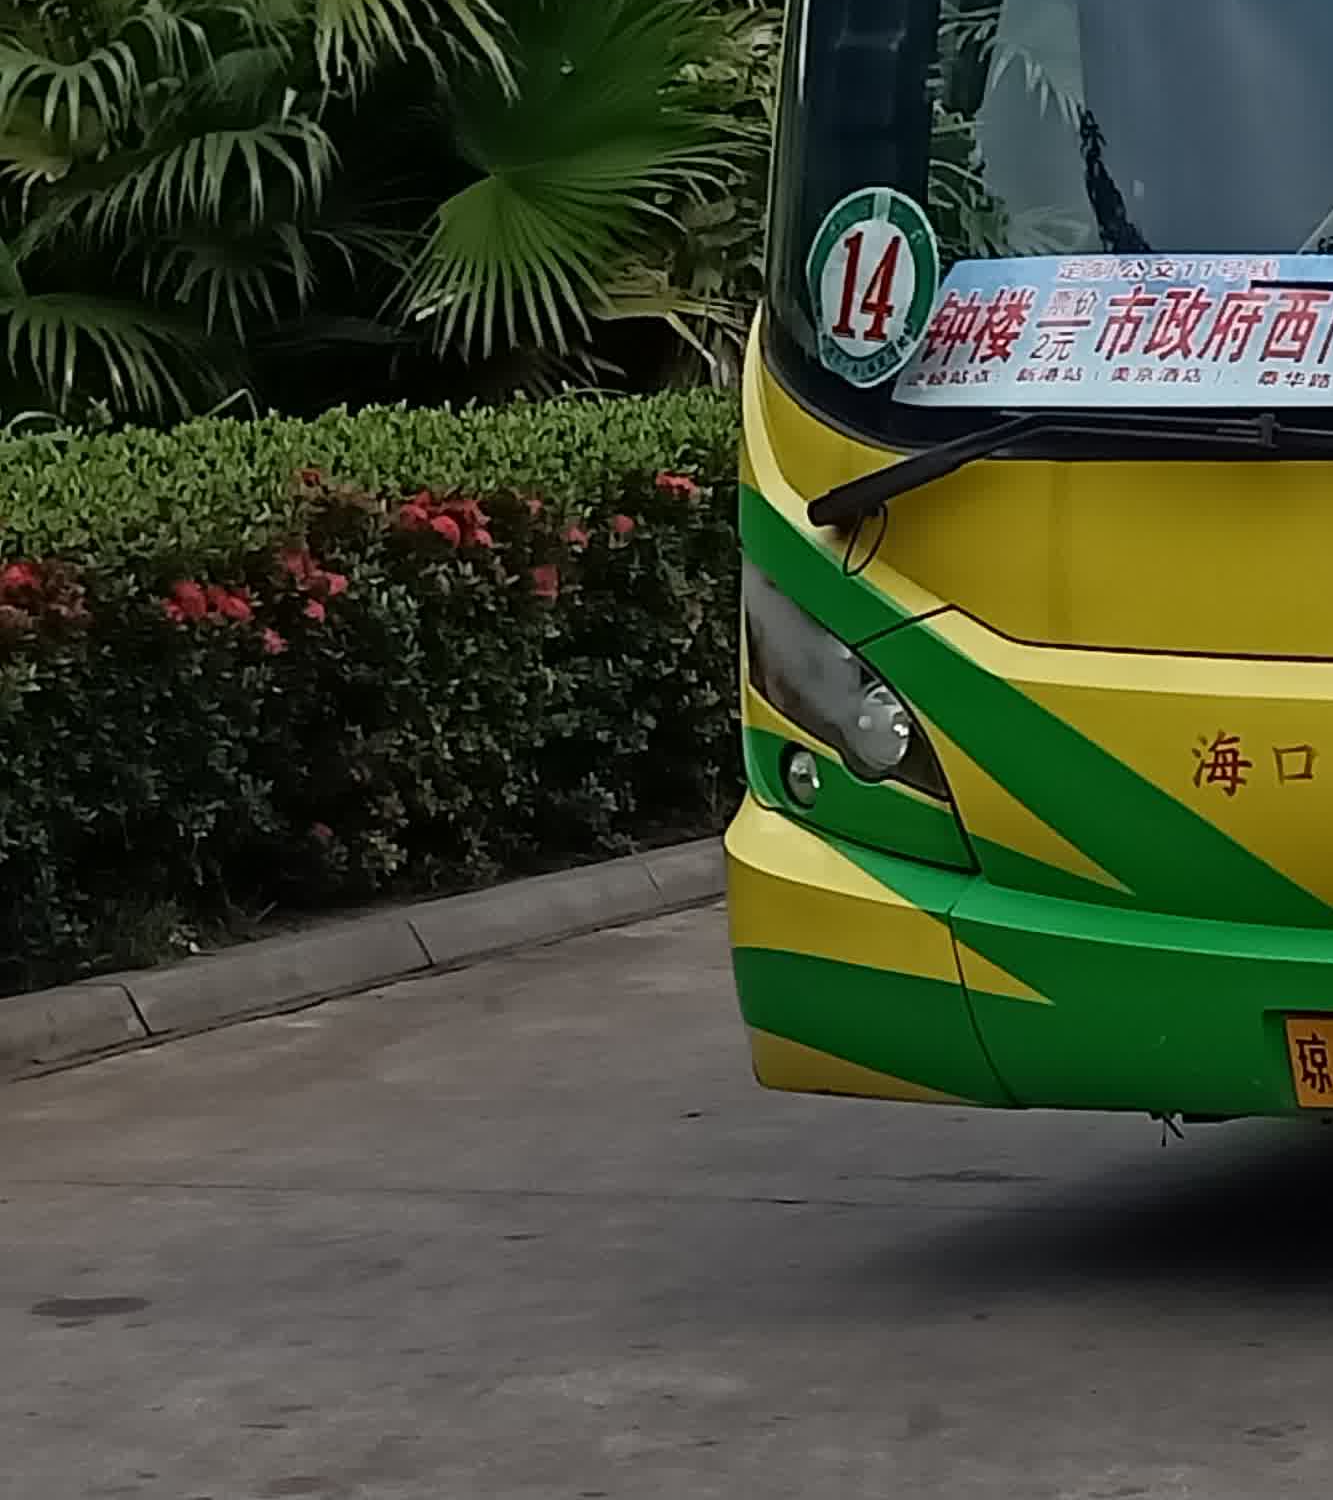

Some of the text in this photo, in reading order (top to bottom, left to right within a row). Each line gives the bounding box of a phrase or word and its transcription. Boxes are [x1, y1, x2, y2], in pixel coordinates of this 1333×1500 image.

[831, 231, 901, 341] 14
[921, 287, 1034, 367] 钟楼
[1029, 331, 1077, 362] 2元
